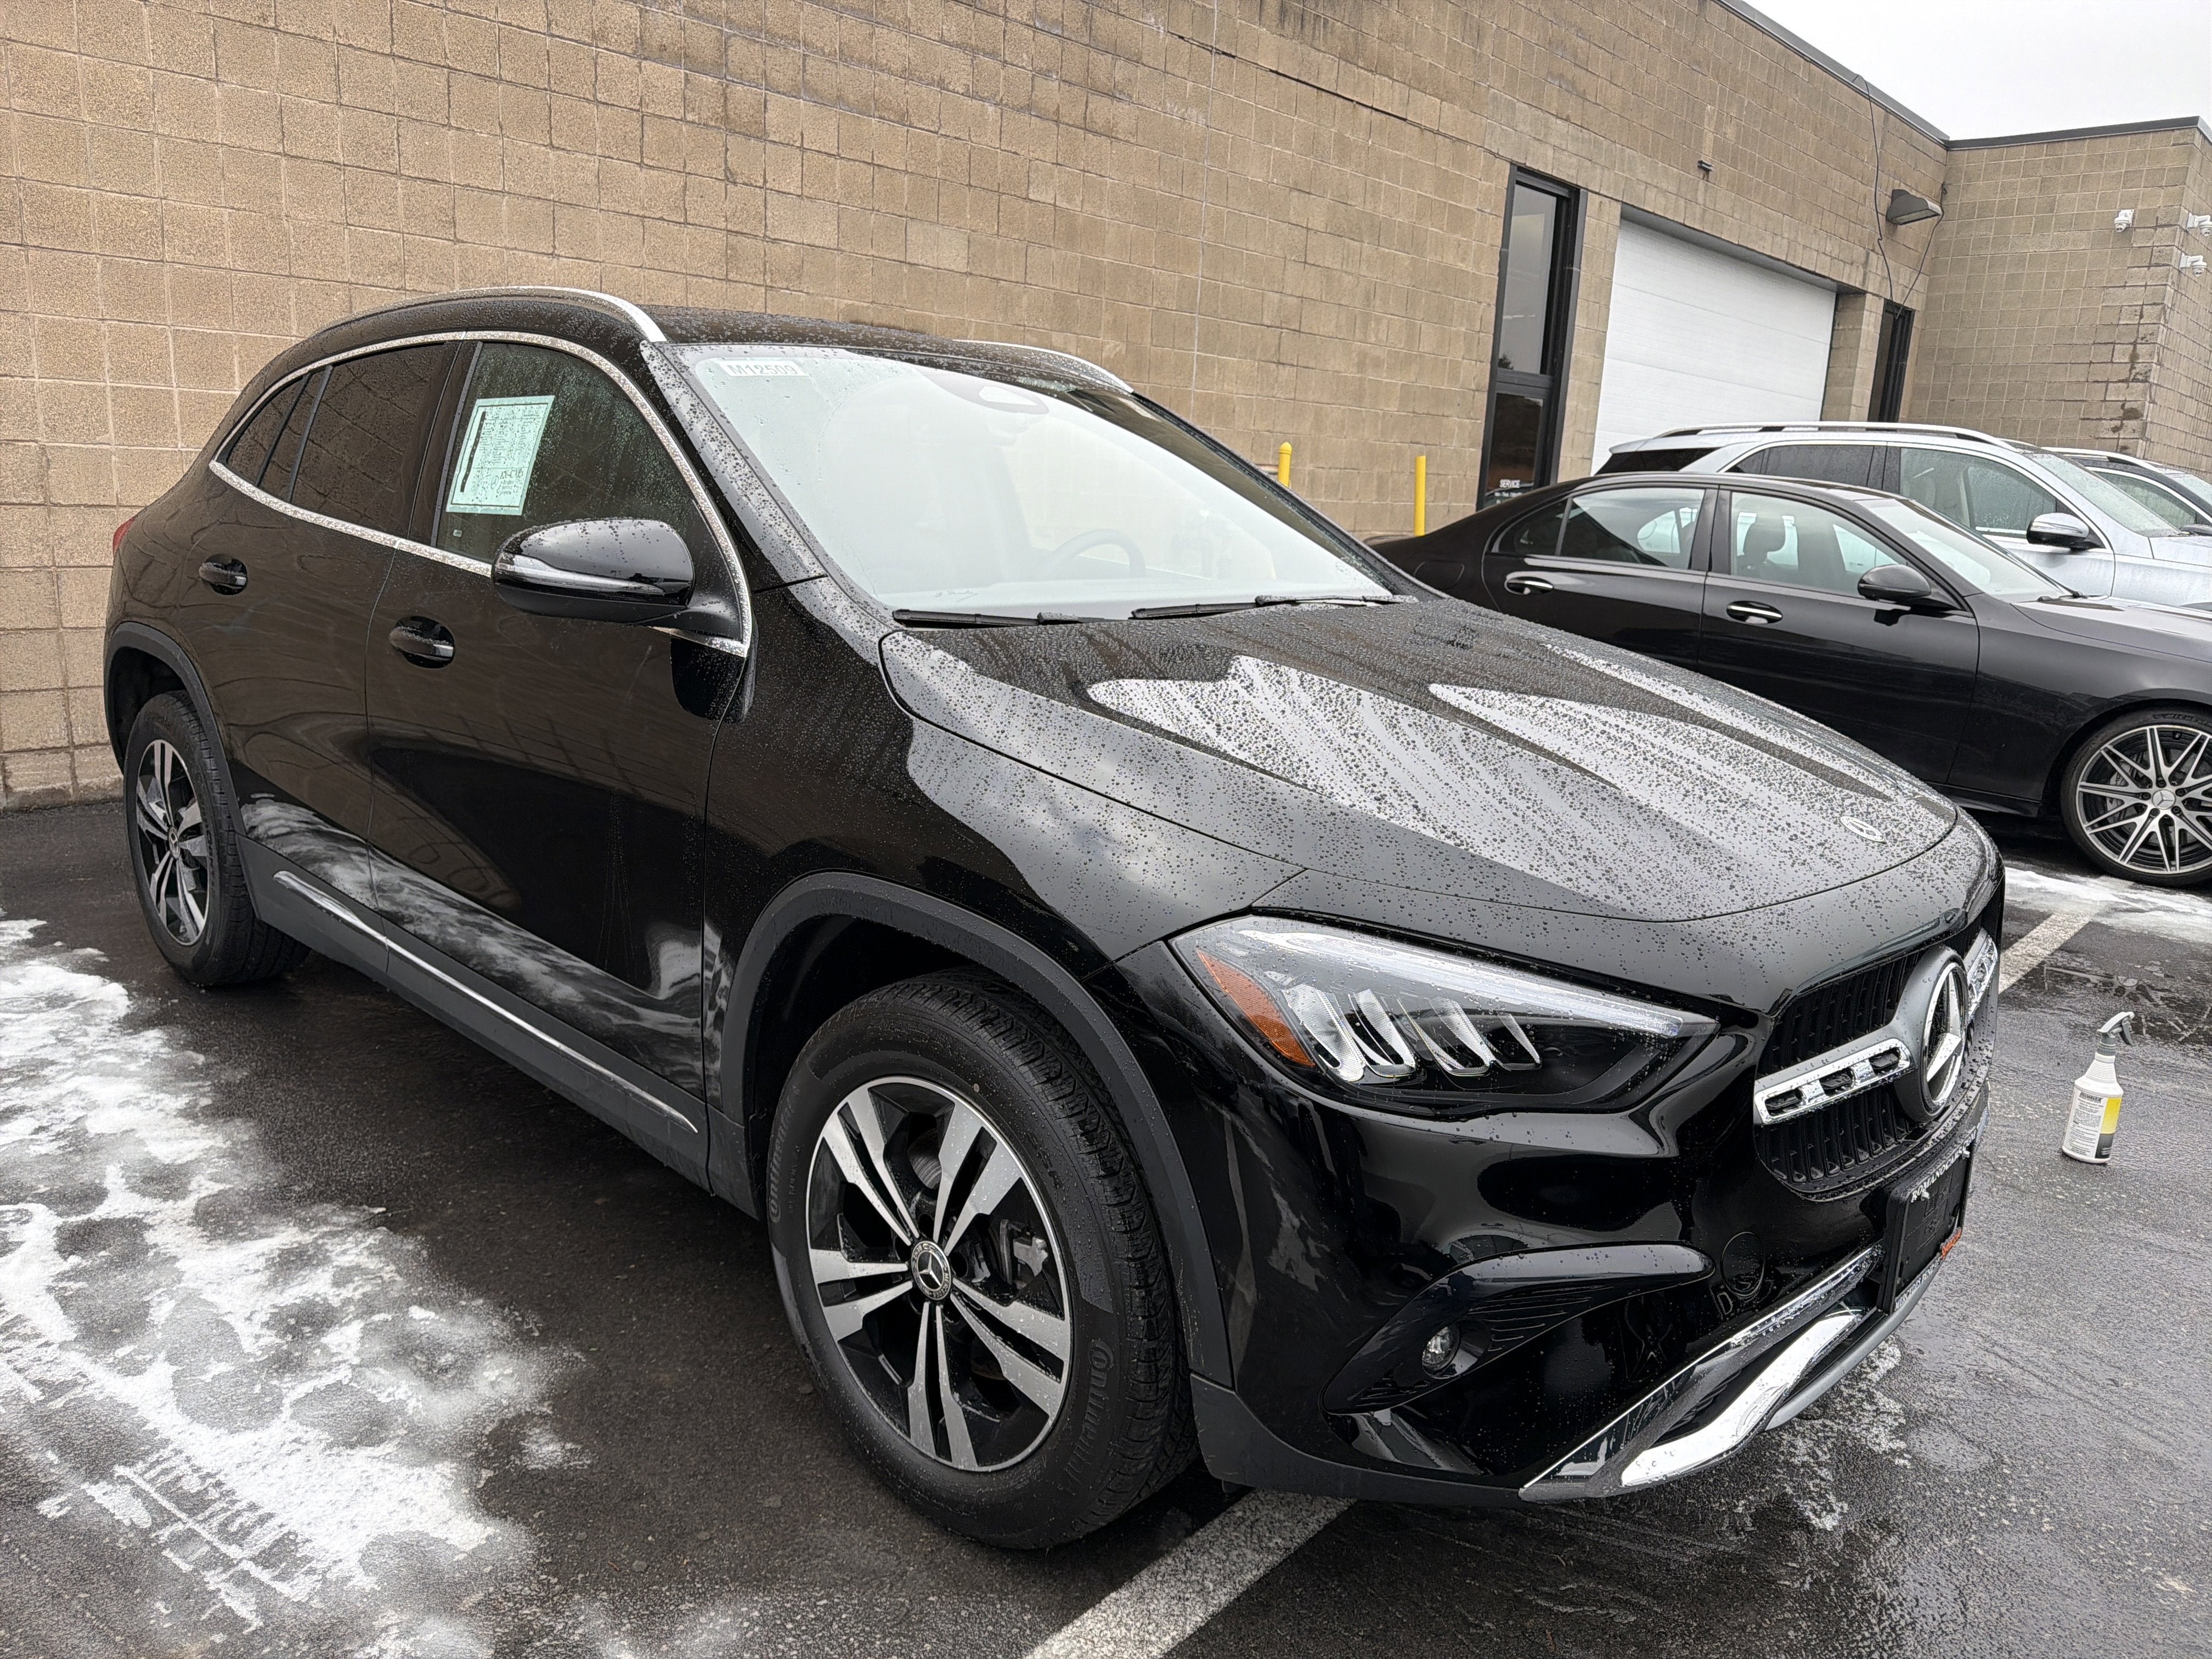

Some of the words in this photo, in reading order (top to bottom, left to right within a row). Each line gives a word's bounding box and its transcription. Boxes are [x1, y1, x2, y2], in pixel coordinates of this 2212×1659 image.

[727, 364, 797, 375] M12509
[1499, 478, 1521, 488] SERVICE
[932, 1273, 950, 1298] MERCEDES
